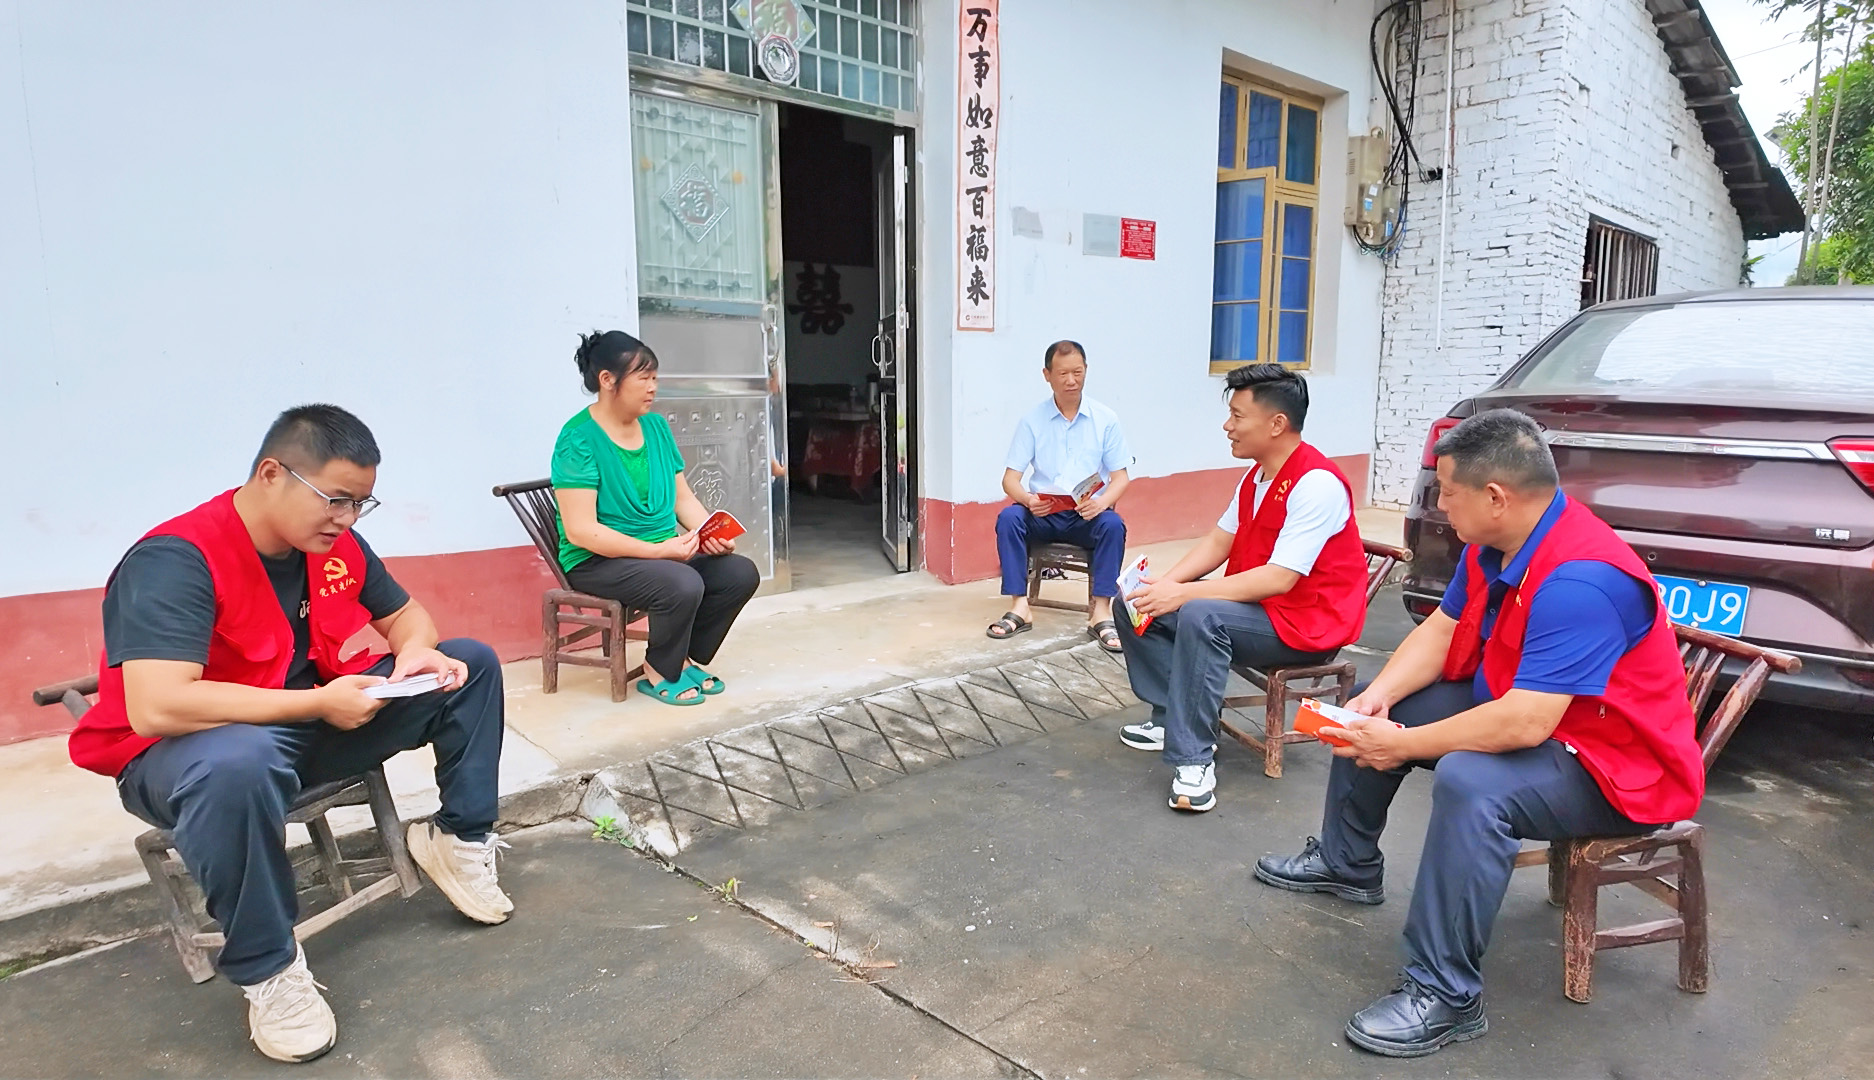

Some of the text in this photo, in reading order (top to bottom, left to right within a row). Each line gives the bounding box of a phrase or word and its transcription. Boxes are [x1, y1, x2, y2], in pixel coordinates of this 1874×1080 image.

[965, 8, 993, 306] 万事如意百福来
